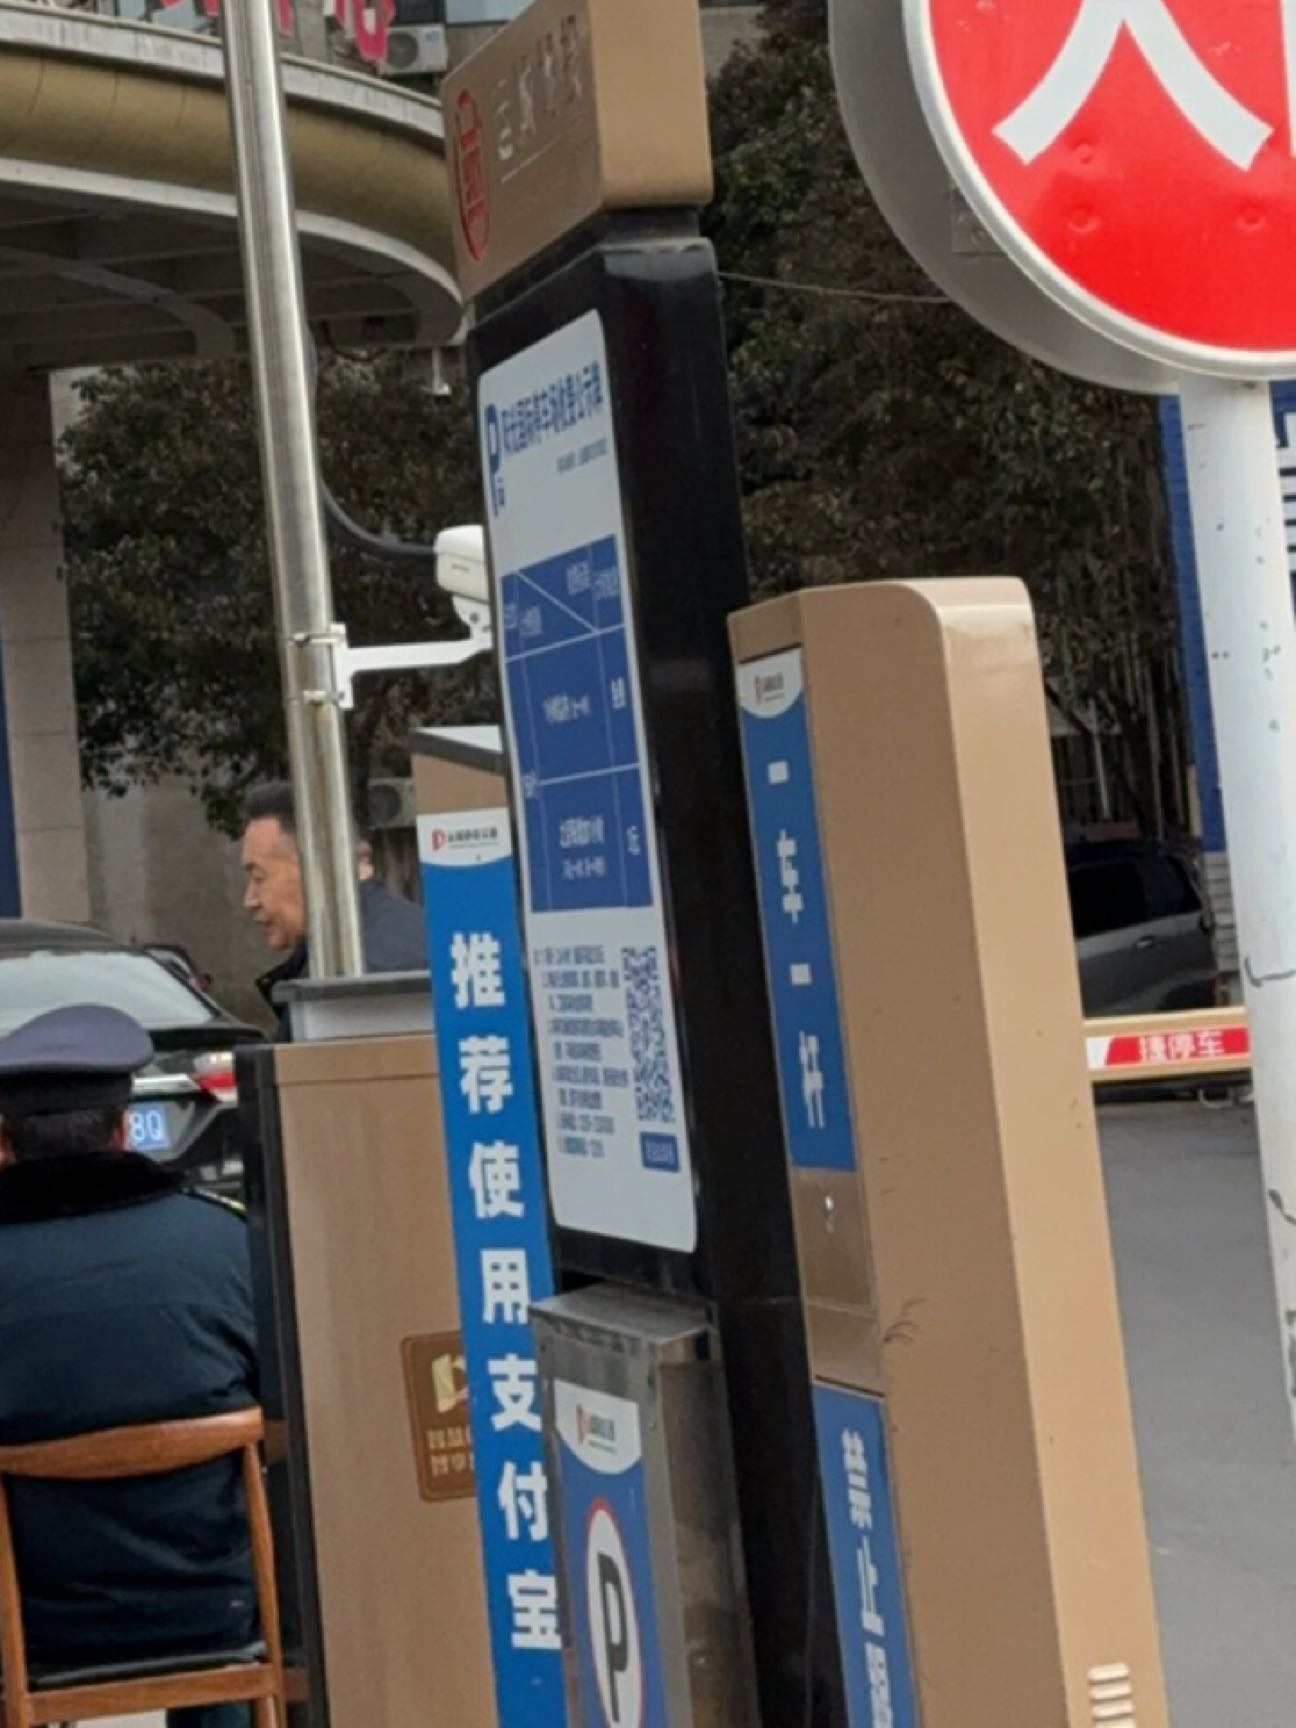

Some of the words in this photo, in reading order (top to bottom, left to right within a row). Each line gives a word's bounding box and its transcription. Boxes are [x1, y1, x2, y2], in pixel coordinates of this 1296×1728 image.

[449, 932, 562, 1651] 推荐使用支付宝
